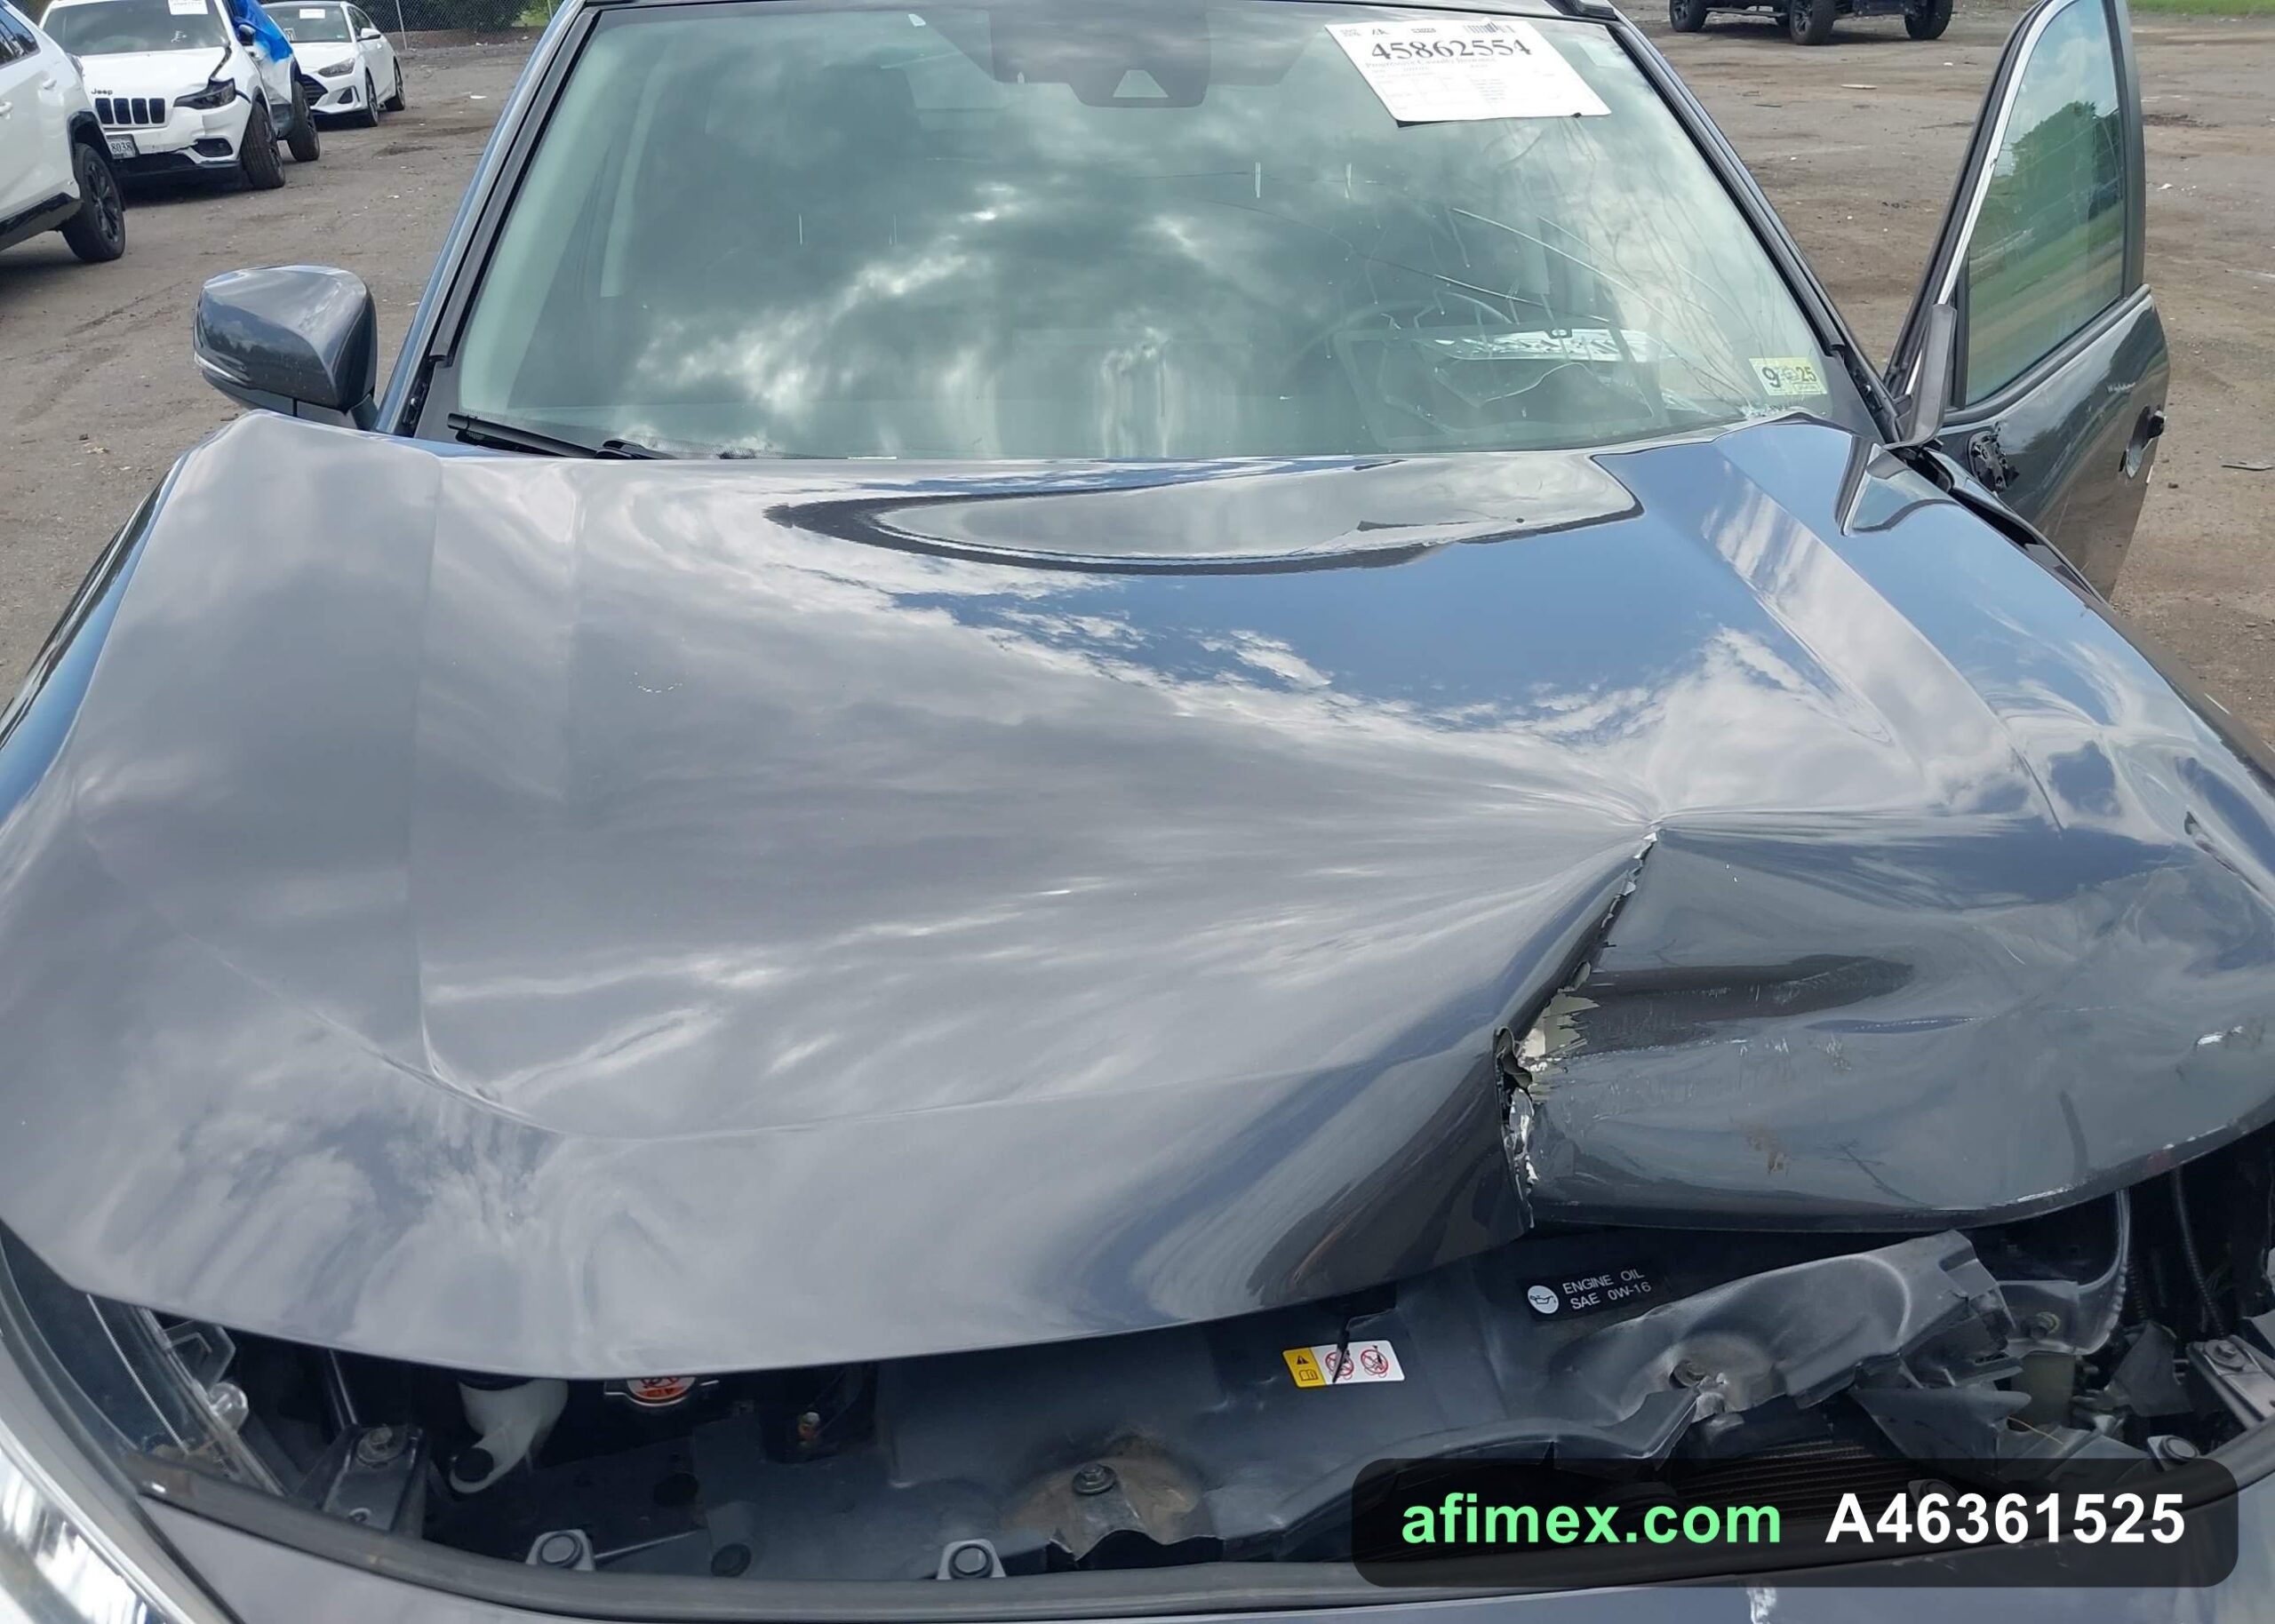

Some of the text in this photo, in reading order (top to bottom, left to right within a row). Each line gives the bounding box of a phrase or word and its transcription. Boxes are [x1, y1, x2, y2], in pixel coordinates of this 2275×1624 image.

[1372, 39, 1532, 60] 45862554
[1761, 367, 1816, 387] 9 25
[1562, 1269, 1645, 1294] ENGINE OIL
[1570, 1282, 1651, 1310] SAE 0W-16
